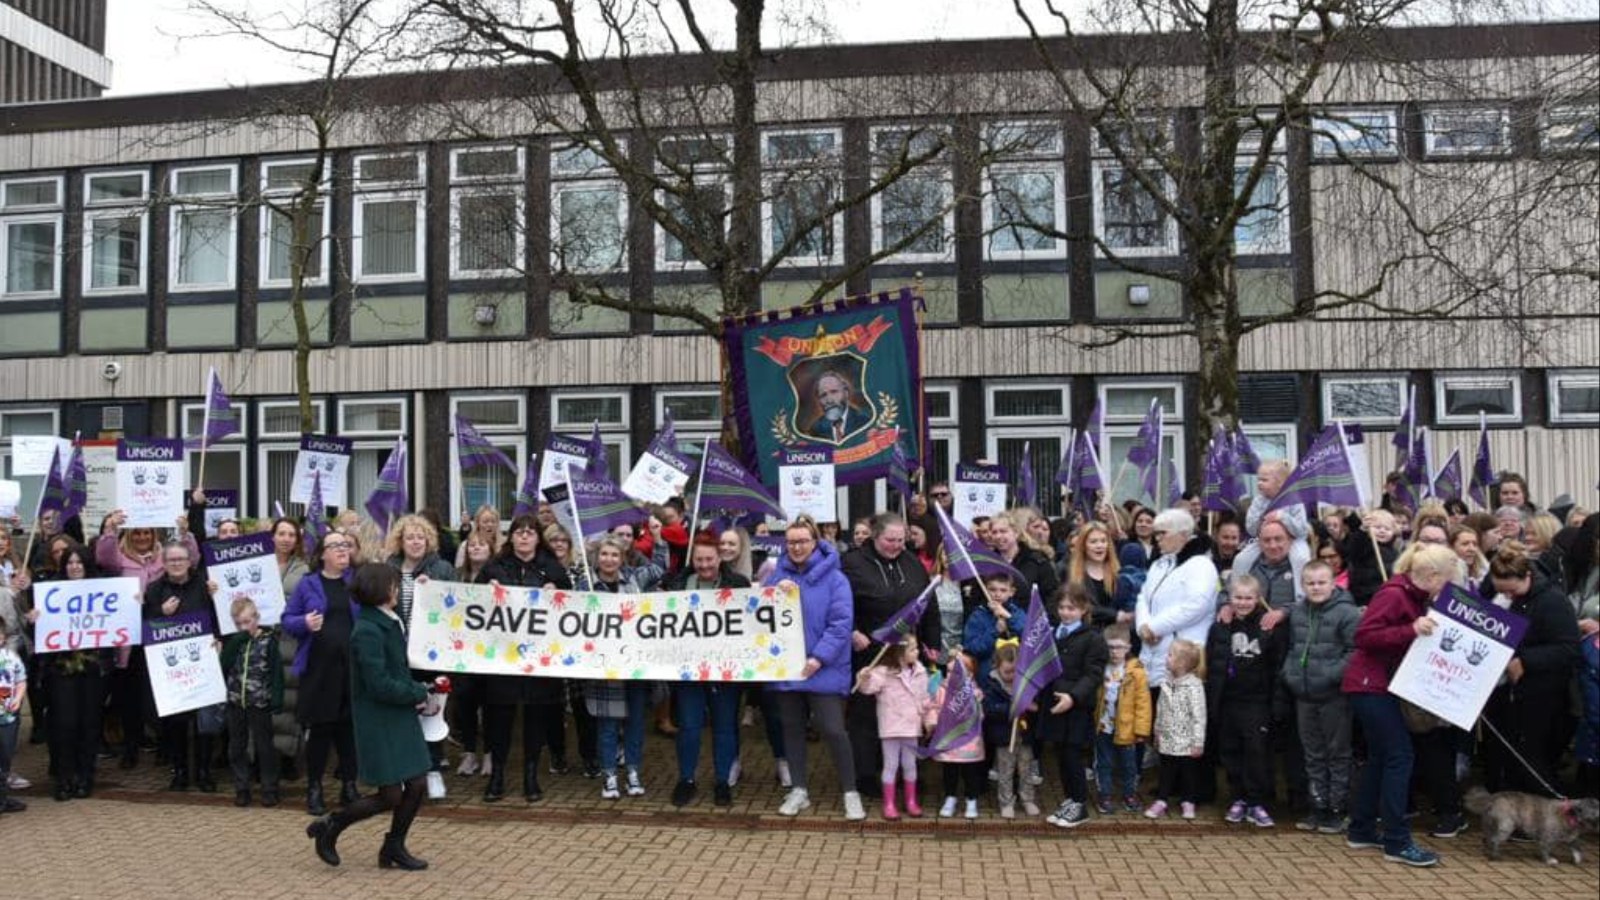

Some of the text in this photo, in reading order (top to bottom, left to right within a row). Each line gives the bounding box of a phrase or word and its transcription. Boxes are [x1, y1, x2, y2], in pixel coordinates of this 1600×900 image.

[126, 447, 174, 459] UNISON
[308, 440, 346, 452] UNISON
[551, 441, 586, 454] UNISON
[653, 447, 688, 471] UNISON
[786, 452, 826, 464] UNISON
[86, 464, 115, 474] Centre
[707, 456, 745, 479] UNISON
[962, 471, 1000, 480] UNISON
[574, 481, 614, 494] UNISON
[213, 542, 264, 562] UNISON
[45, 587, 119, 614] Care
[69, 614, 112, 630] NOT
[465, 604, 548, 635] SAVE
[558, 611, 623, 640] OUR
[636, 609, 744, 639] GRADE
[1447, 599, 1511, 639] UNISON
[44, 627, 130, 650] CUTS
[152, 621, 203, 641] UNISON
